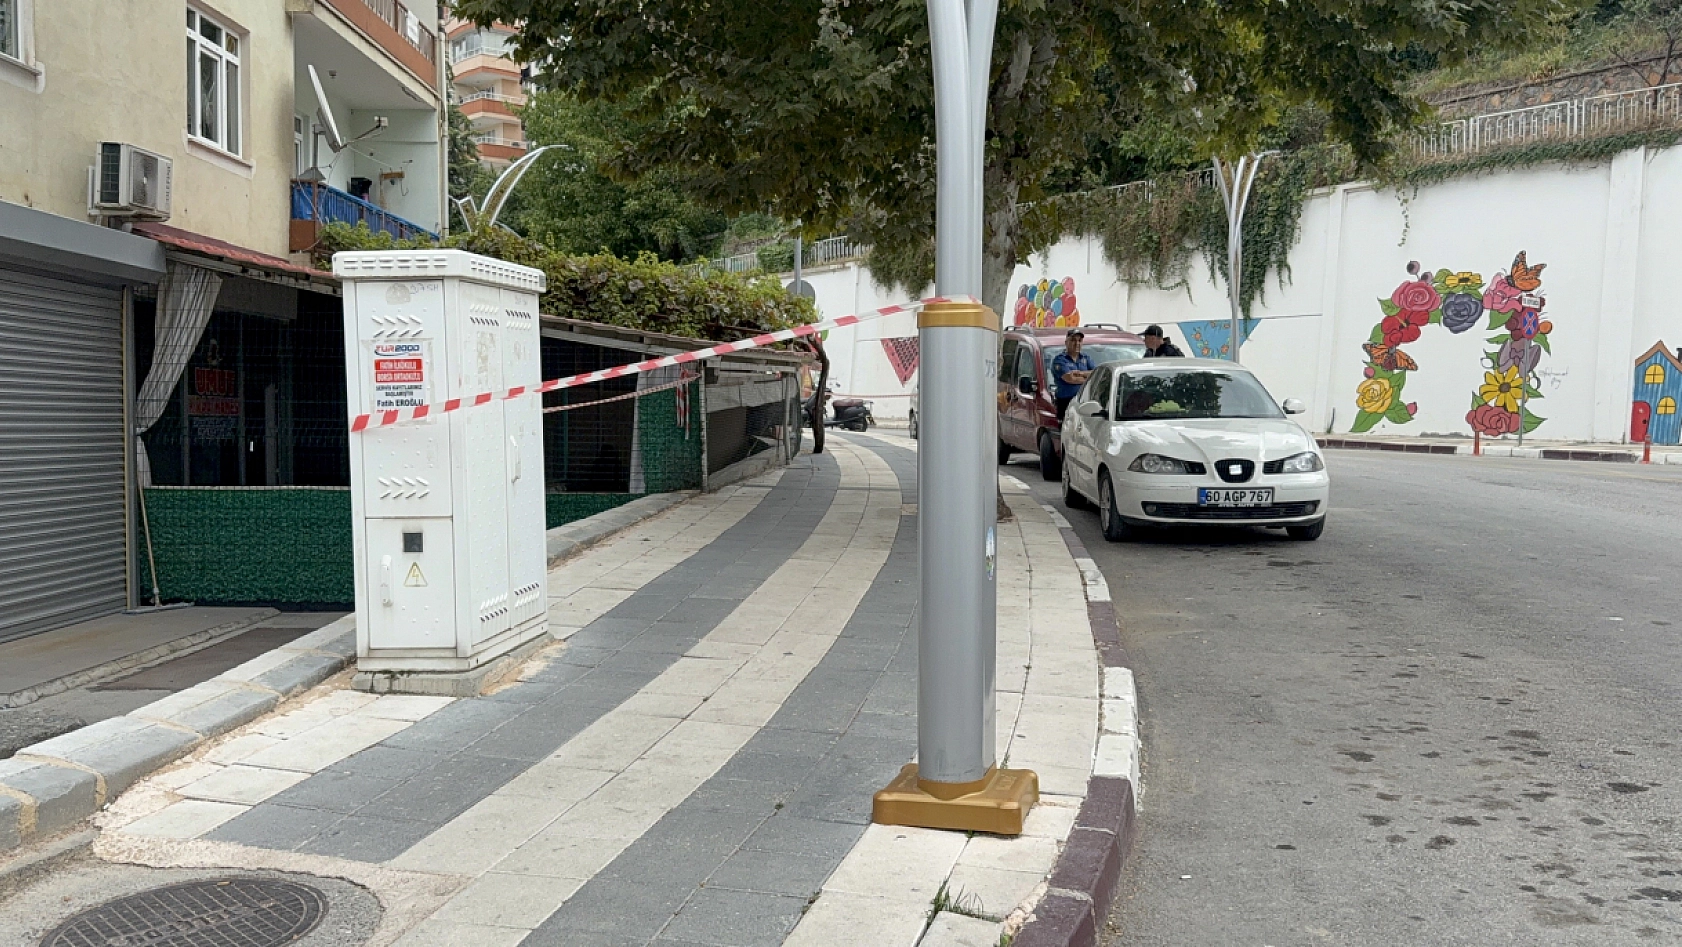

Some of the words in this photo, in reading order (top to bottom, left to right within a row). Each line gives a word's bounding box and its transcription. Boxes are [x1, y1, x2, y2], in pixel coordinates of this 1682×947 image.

[375, 344, 420, 353] TUR2000
[376, 399, 394, 407] Fatih
[395, 398, 424, 407] EROĞLU
[1206, 490, 1220, 502] 60
[1223, 490, 1247, 502] AGP
[1249, 490, 1271, 502] 767
